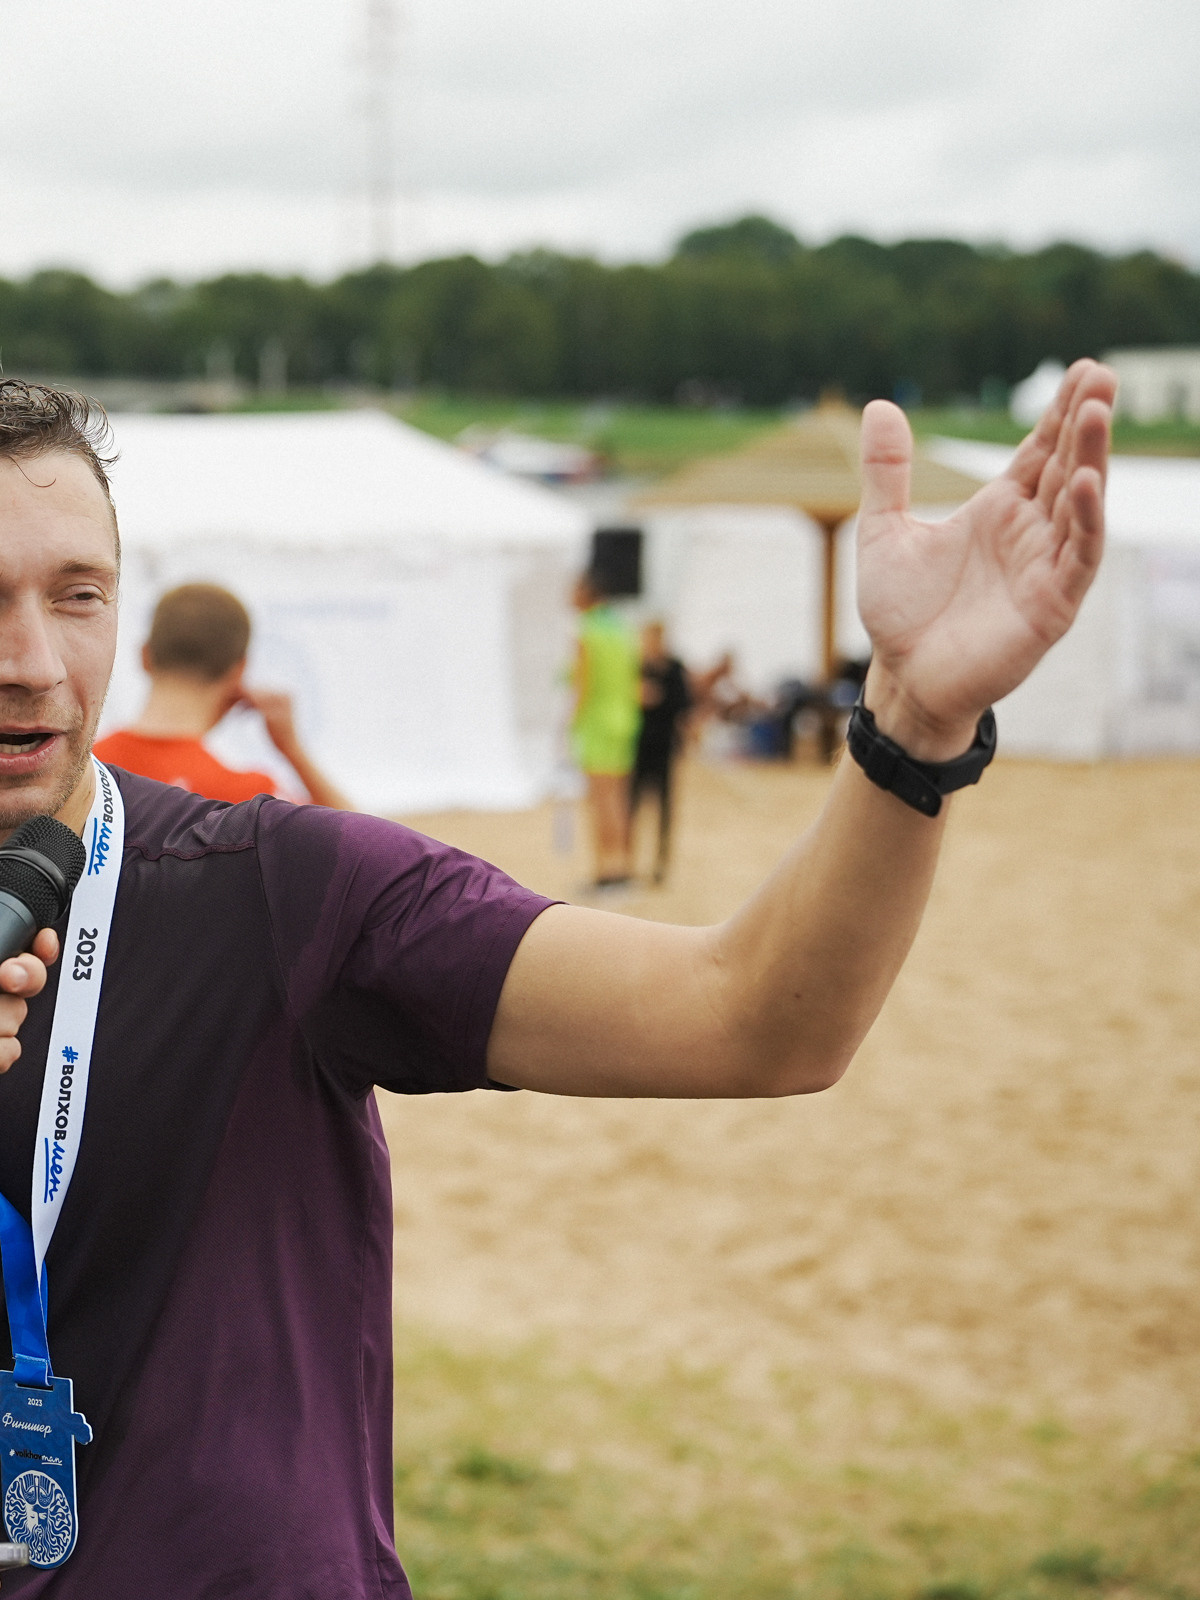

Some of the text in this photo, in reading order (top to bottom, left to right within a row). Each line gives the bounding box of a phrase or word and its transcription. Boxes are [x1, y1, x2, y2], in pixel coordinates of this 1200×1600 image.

[72, 927, 99, 981] 2023
[27, 1397, 43, 1407] 2023
[1, 1412, 53, 1439] Финишер
